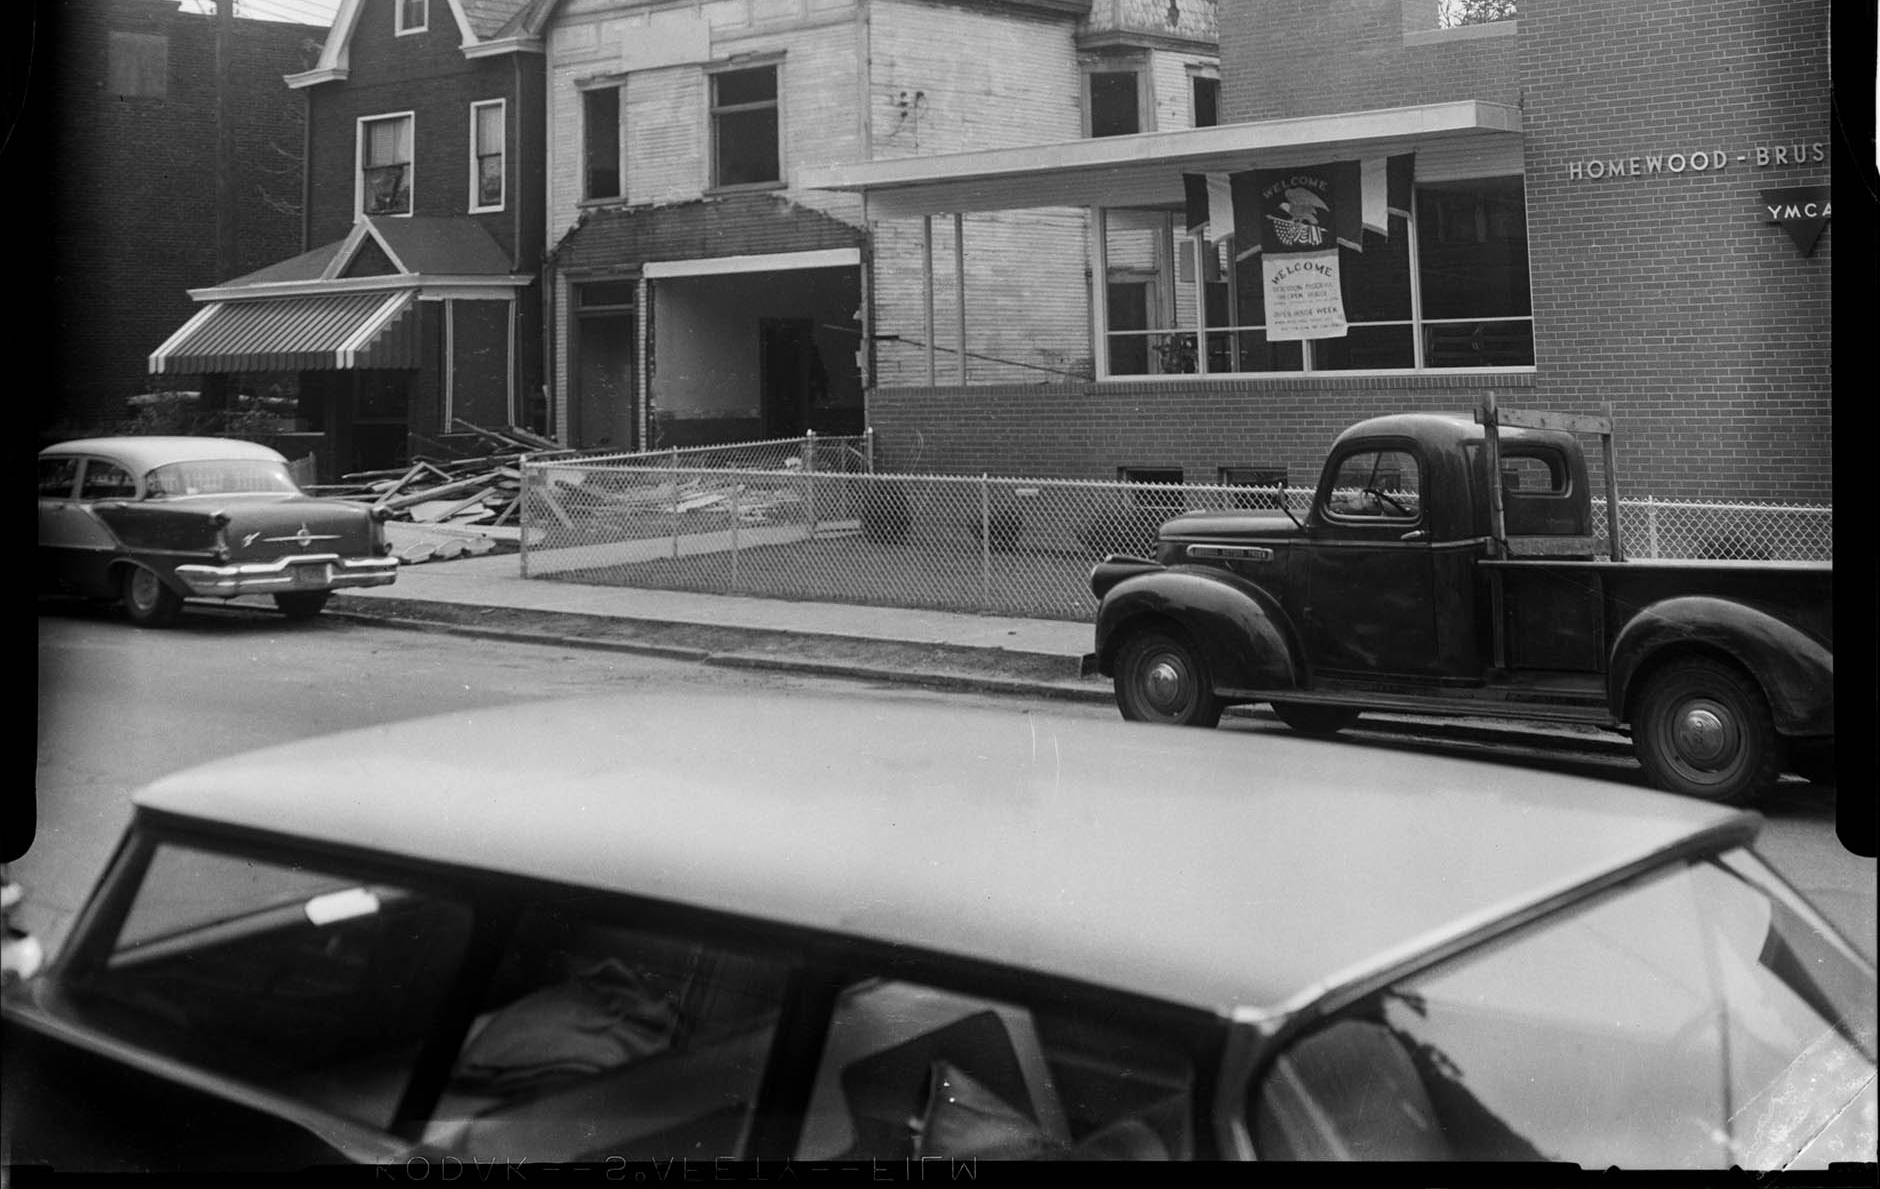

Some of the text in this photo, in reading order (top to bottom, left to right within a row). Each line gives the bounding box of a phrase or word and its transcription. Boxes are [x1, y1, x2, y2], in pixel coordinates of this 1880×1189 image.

[1262, 175, 1328, 199] WELCOME
[1767, 203, 1831, 219] YMCA
[1272, 261, 1333, 285] WELCOME
